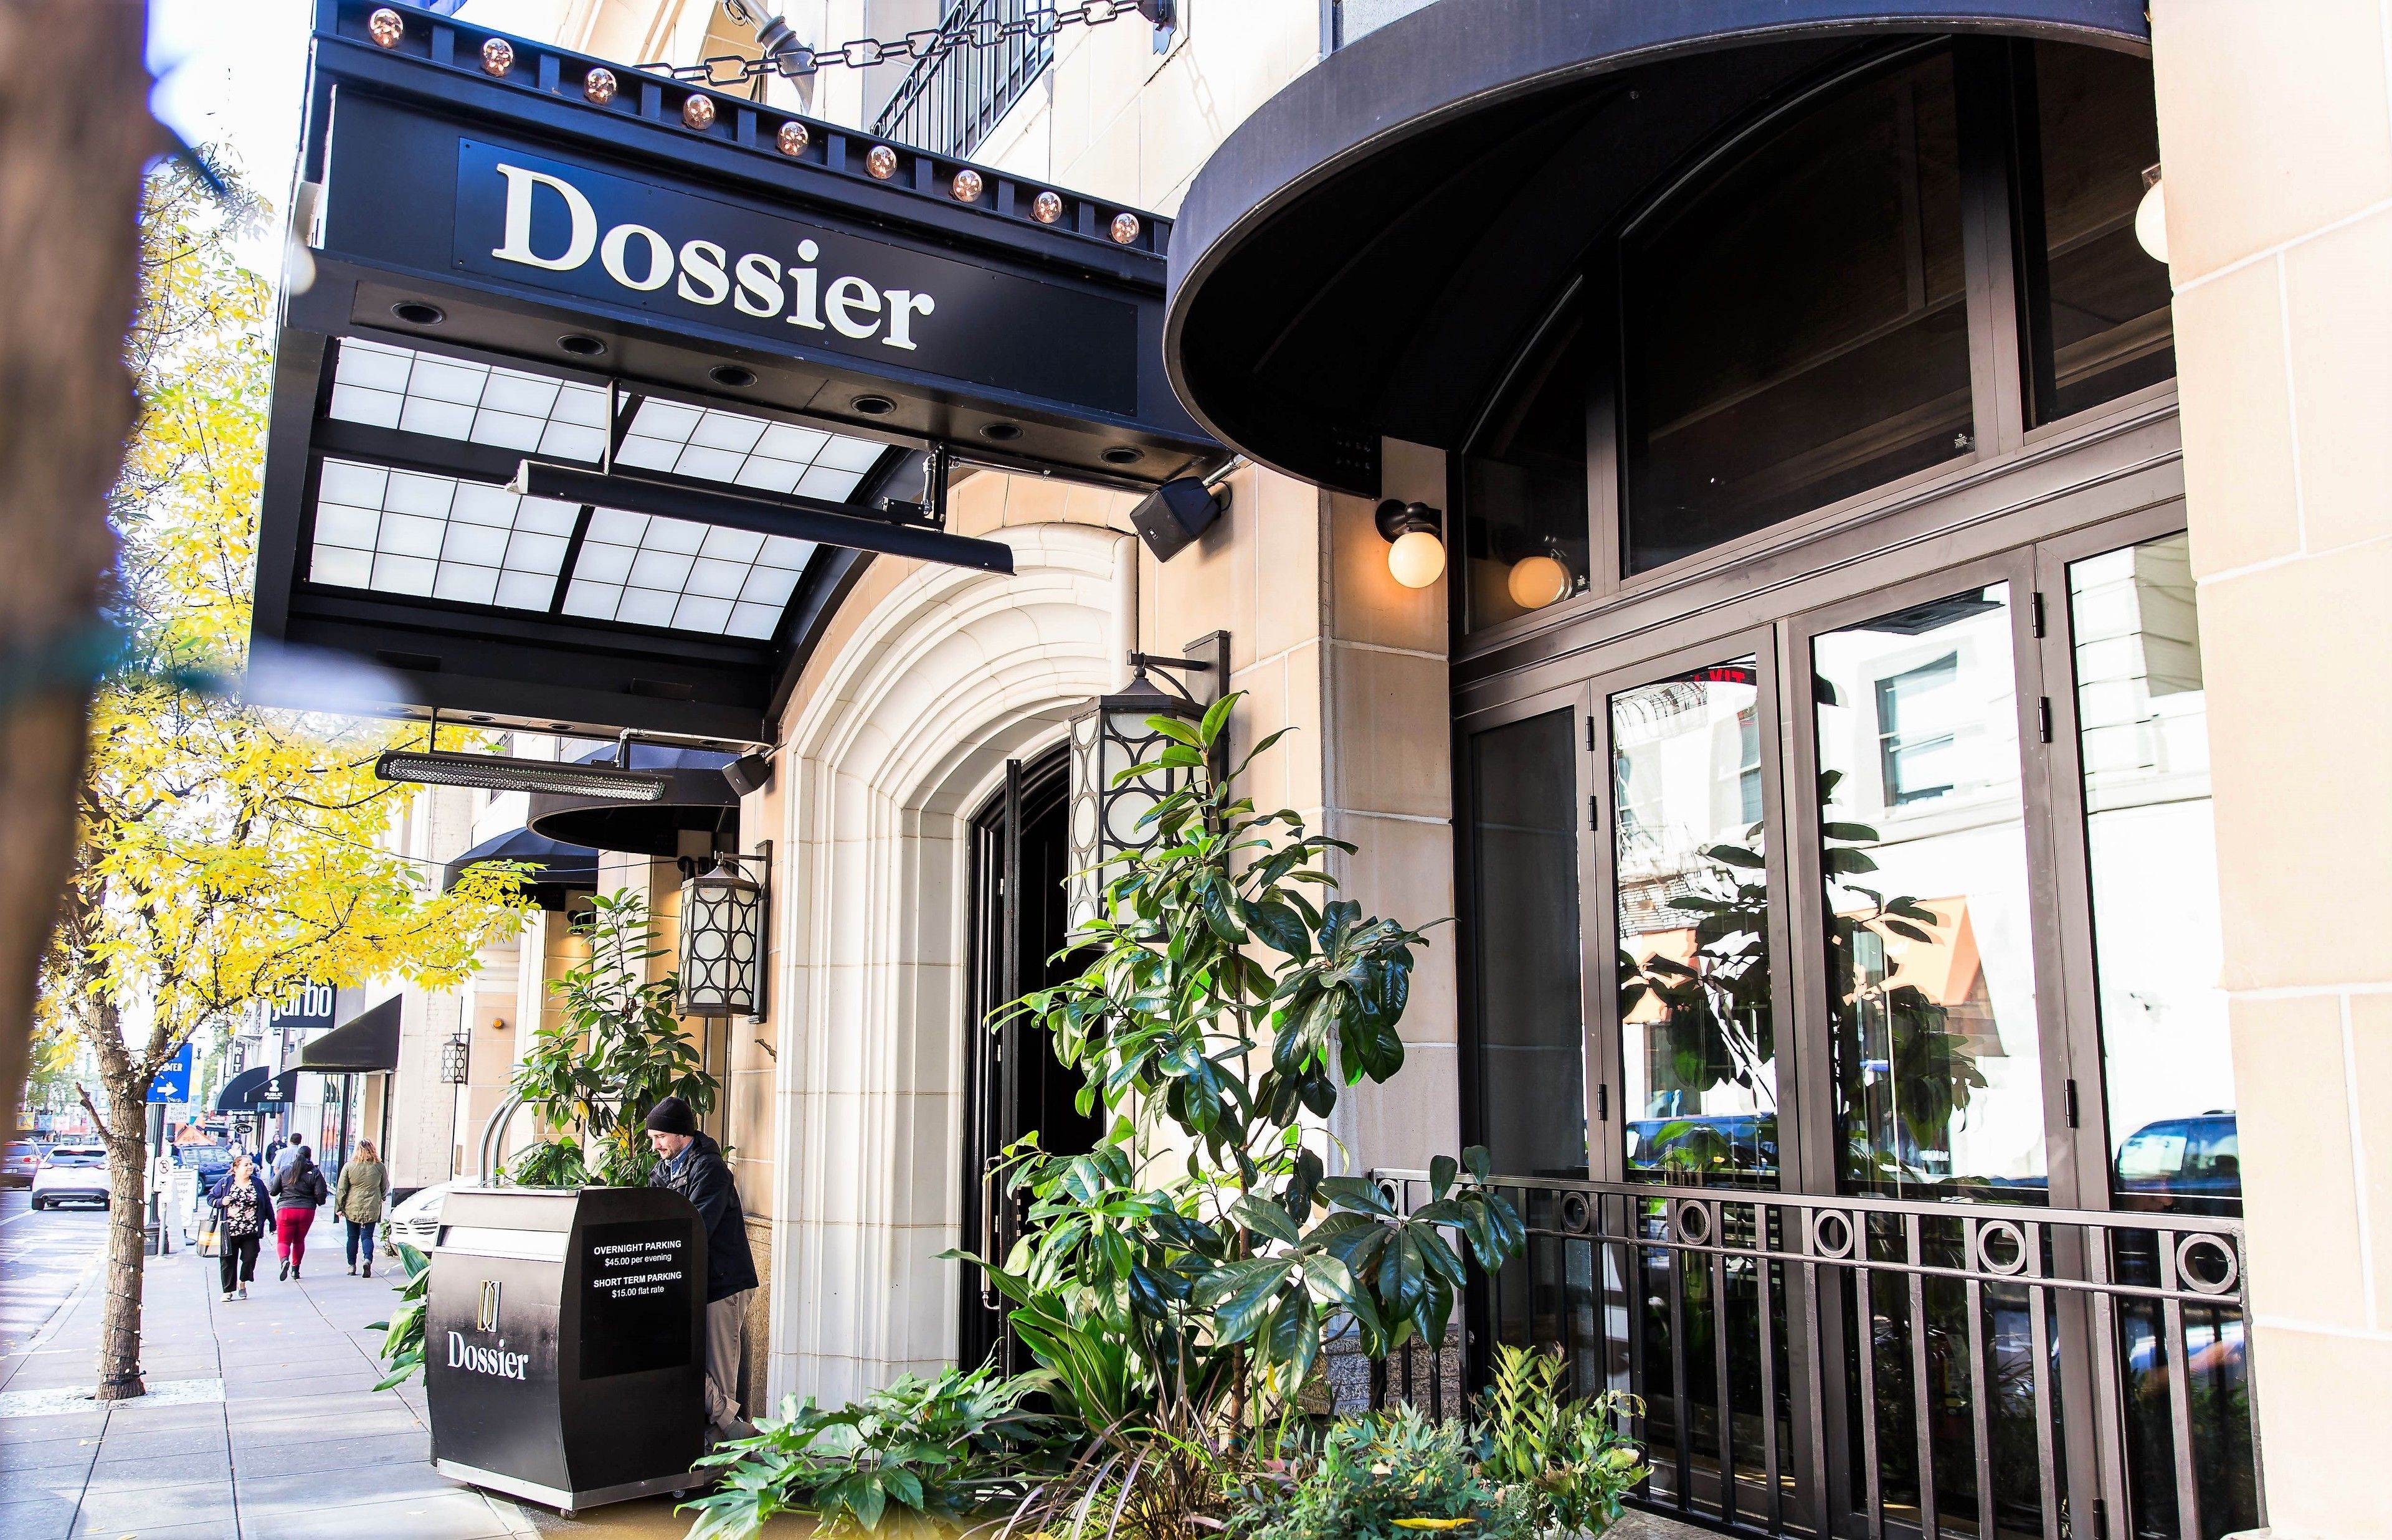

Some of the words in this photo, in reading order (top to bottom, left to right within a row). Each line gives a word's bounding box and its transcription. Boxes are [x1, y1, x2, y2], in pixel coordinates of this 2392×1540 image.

[491, 163, 936, 351] Dossier
[594, 1243, 643, 1255] OVERNIGHT
[645, 1240, 681, 1250] PARKING
[605, 1257, 630, 1267] $45.00
[631, 1256, 643, 1265] per
[644, 1253, 672, 1262] evening
[593, 1277, 622, 1288] SHORT
[623, 1275, 645, 1285] TERM
[647, 1271, 682, 1282] PARKING
[612, 1288, 637, 1298] $15.00
[638, 1287, 650, 1295] flat
[650, 1285, 665, 1293] rate
[447, 1330, 529, 1381] Dossier
